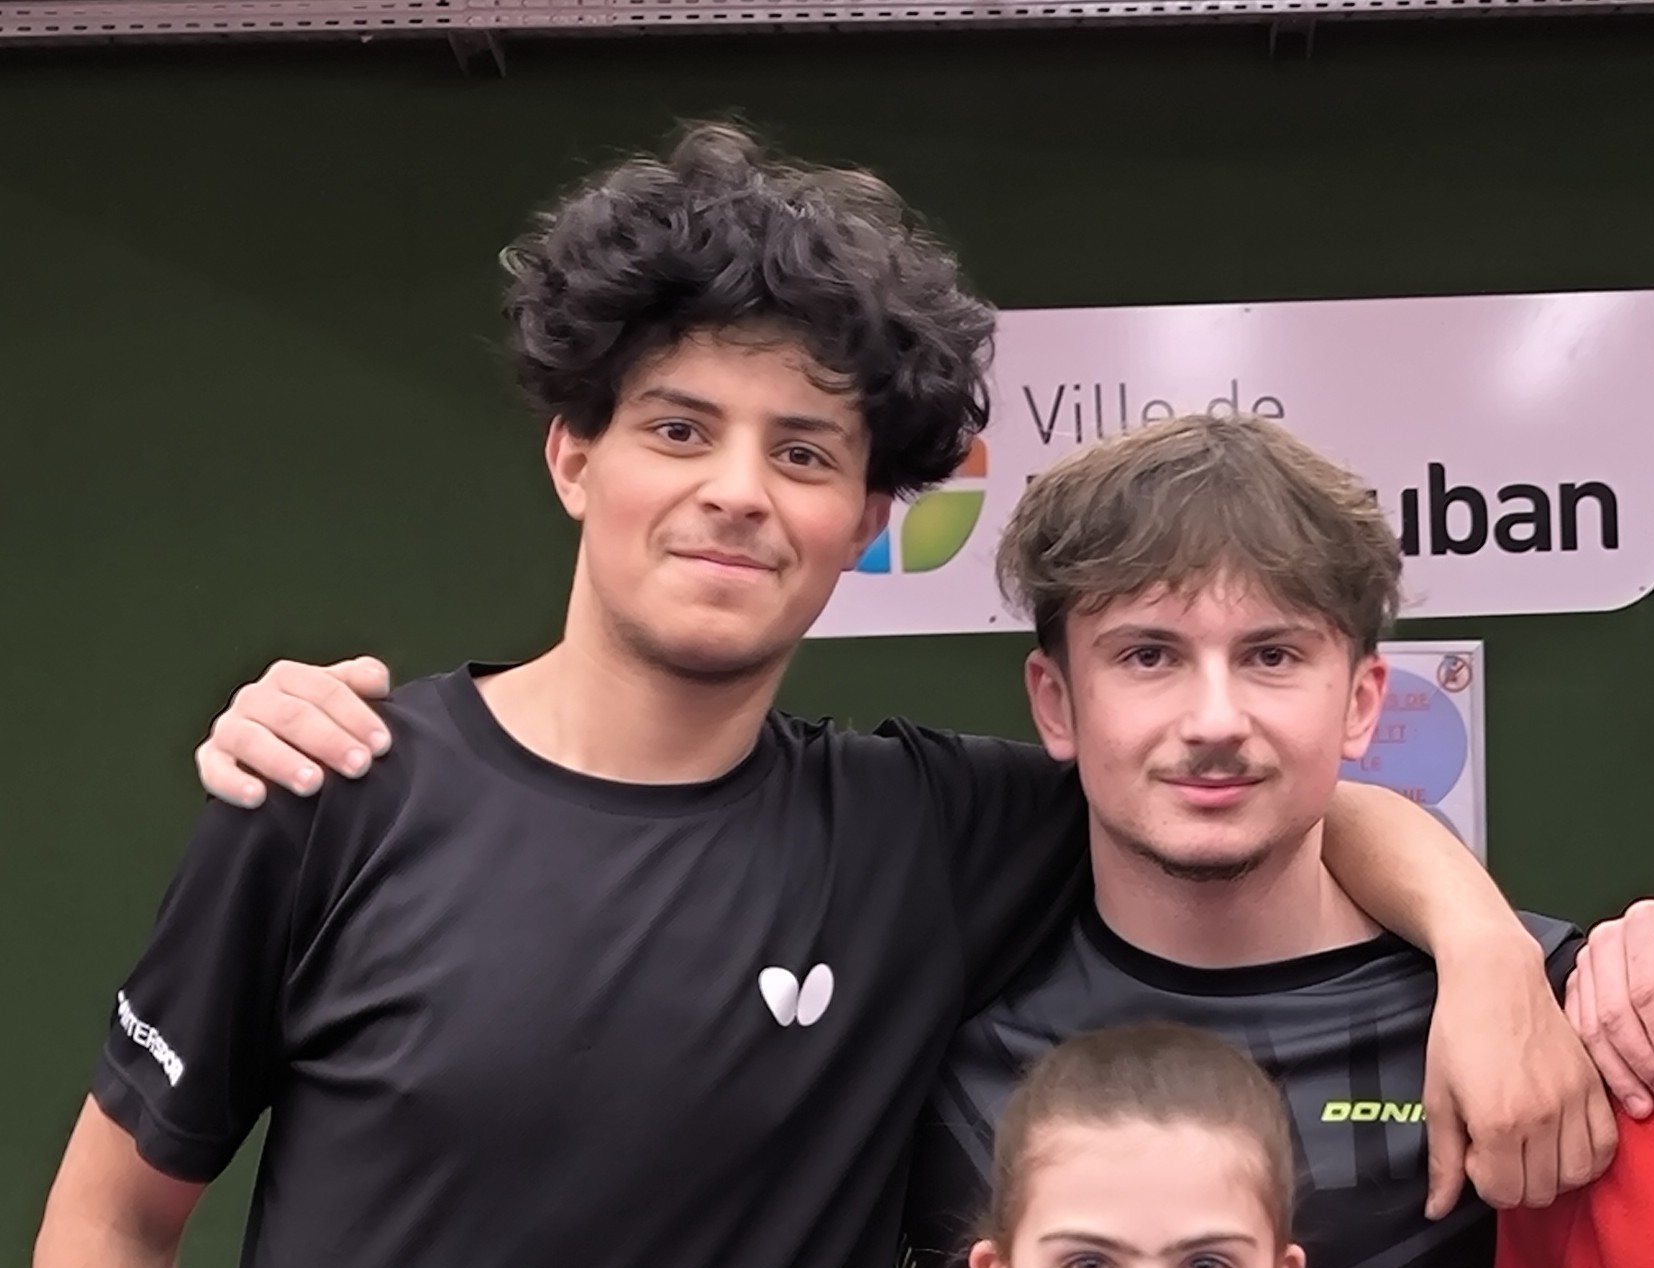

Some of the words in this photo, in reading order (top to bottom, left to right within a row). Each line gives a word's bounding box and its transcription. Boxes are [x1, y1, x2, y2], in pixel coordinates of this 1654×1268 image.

[1023, 382, 1175, 444] Ville
[1206, 378, 1285, 422] de
[1320, 1102, 1427, 1123] DONI
